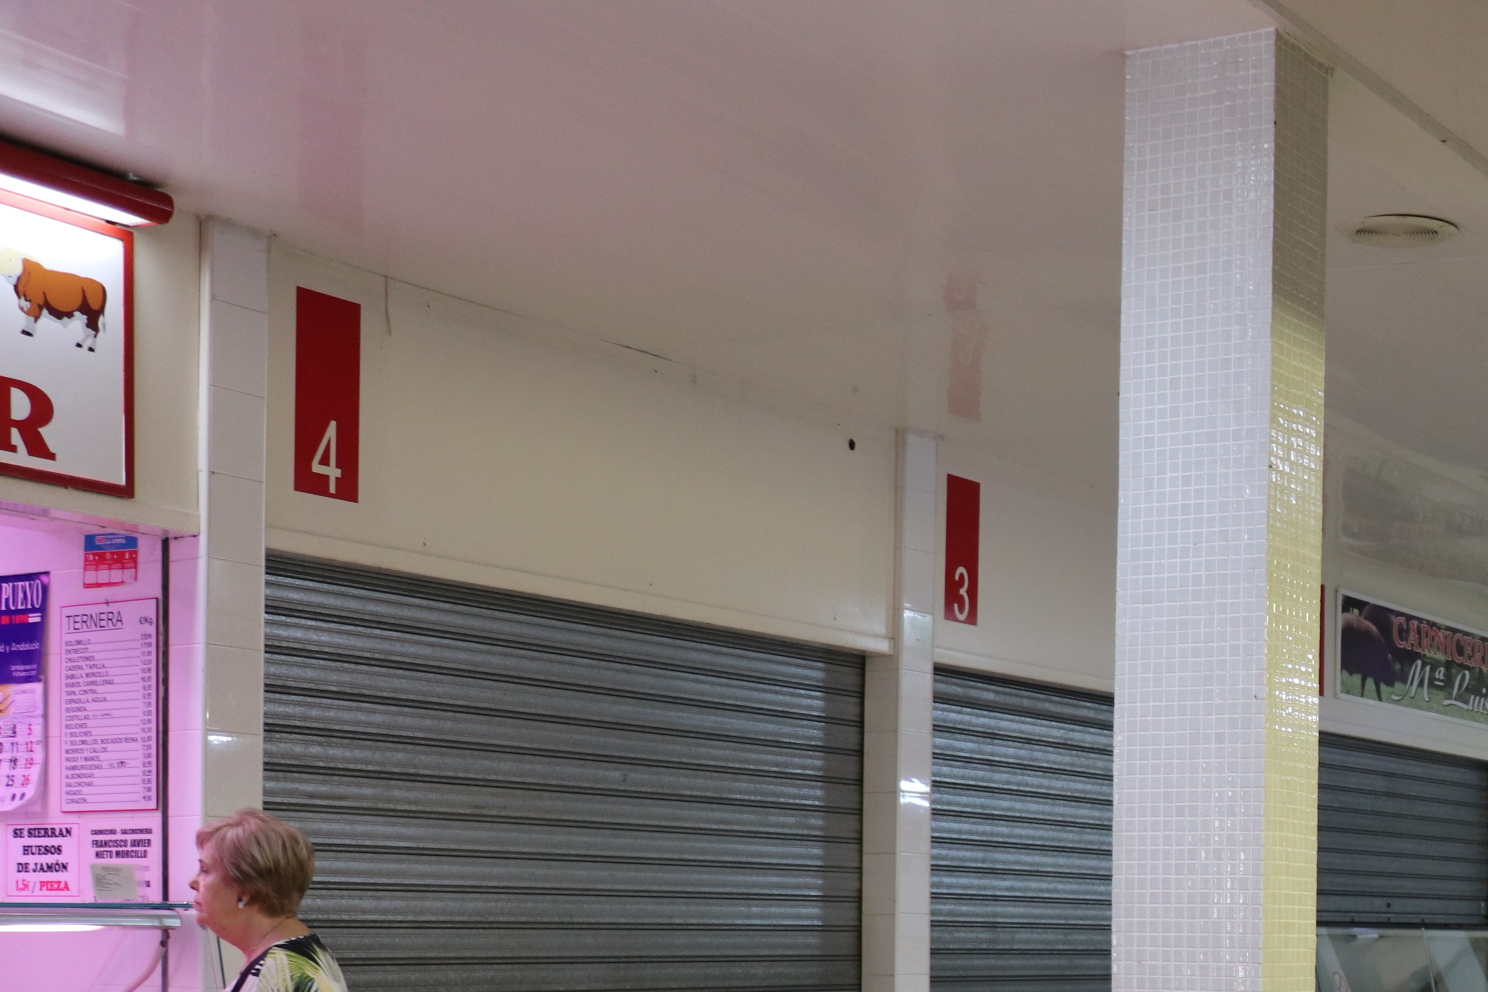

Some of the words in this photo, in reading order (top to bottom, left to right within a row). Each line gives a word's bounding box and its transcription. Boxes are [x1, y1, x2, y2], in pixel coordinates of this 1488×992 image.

[311, 420, 342, 494] 4
[1, 580, 42, 611] PUEYO
[954, 566, 969, 621] 3
[65, 611, 124, 630] TERNERA
[6, 775, 15, 787] 25
[21, 774, 31, 786] 26
[13, 828, 25, 838] SE
[27, 827, 72, 838] SIERRAN
[92, 839, 128, 848] FRANCISCO
[129, 838, 151, 847] JAVIER
[22, 845, 62, 855] HUESOS
[95, 850, 114, 859] NIETO
[115, 850, 147, 858] MORCILLO
[16, 863, 30, 873] DE
[32, 860, 68, 873] JAMÓN
[39, 881, 70, 891] PIEZA
